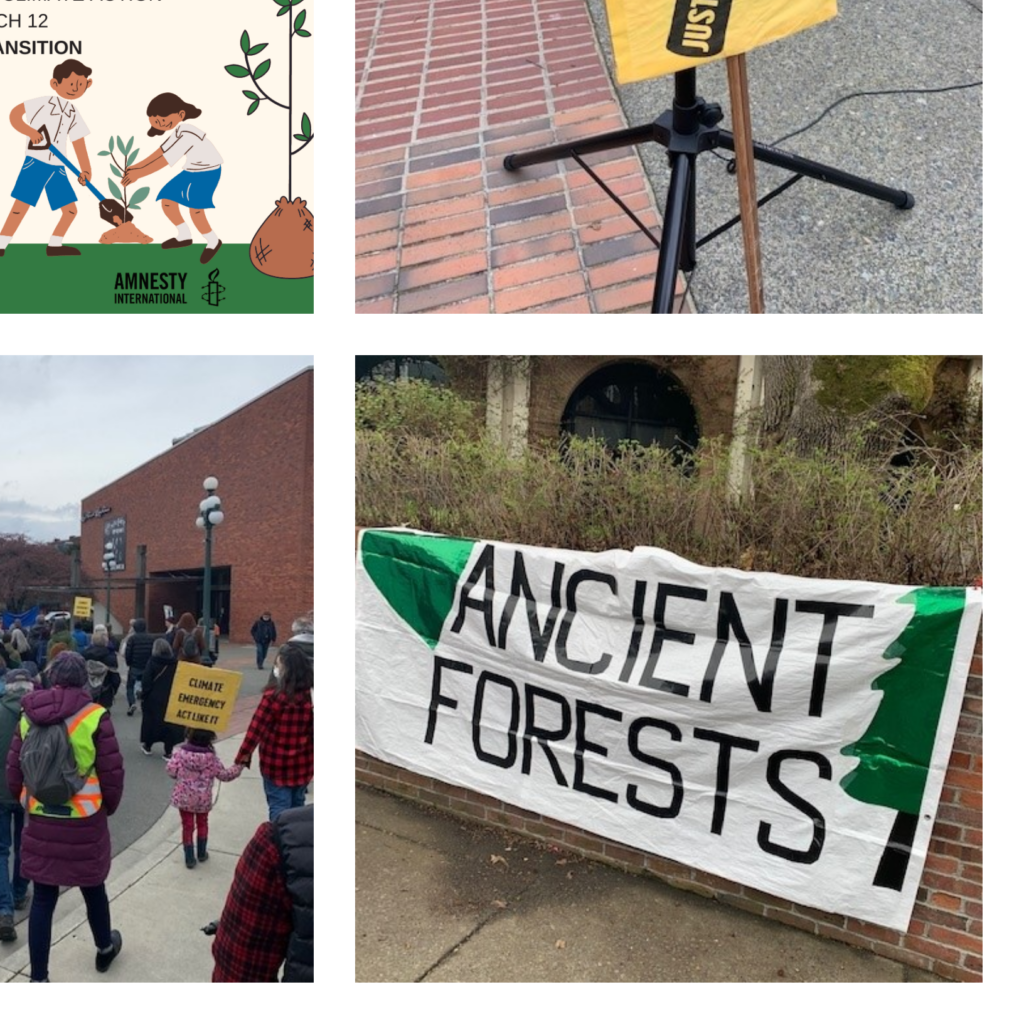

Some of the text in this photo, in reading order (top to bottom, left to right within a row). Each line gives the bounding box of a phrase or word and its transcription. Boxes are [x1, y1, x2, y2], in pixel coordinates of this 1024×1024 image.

[29, 13, 49, 29] 12
[114, 272, 188, 290] AMNESTY
[114, 293, 188, 304] INTERNATIONAL
[450, 544, 874, 717] ANCIENT
[188, 677, 224, 693] CLIMATE
[177, 693, 226, 710] EMERGENCY
[176, 709, 219, 725] ACT LIKE IT
[424, 655, 833, 865] FORESTS
